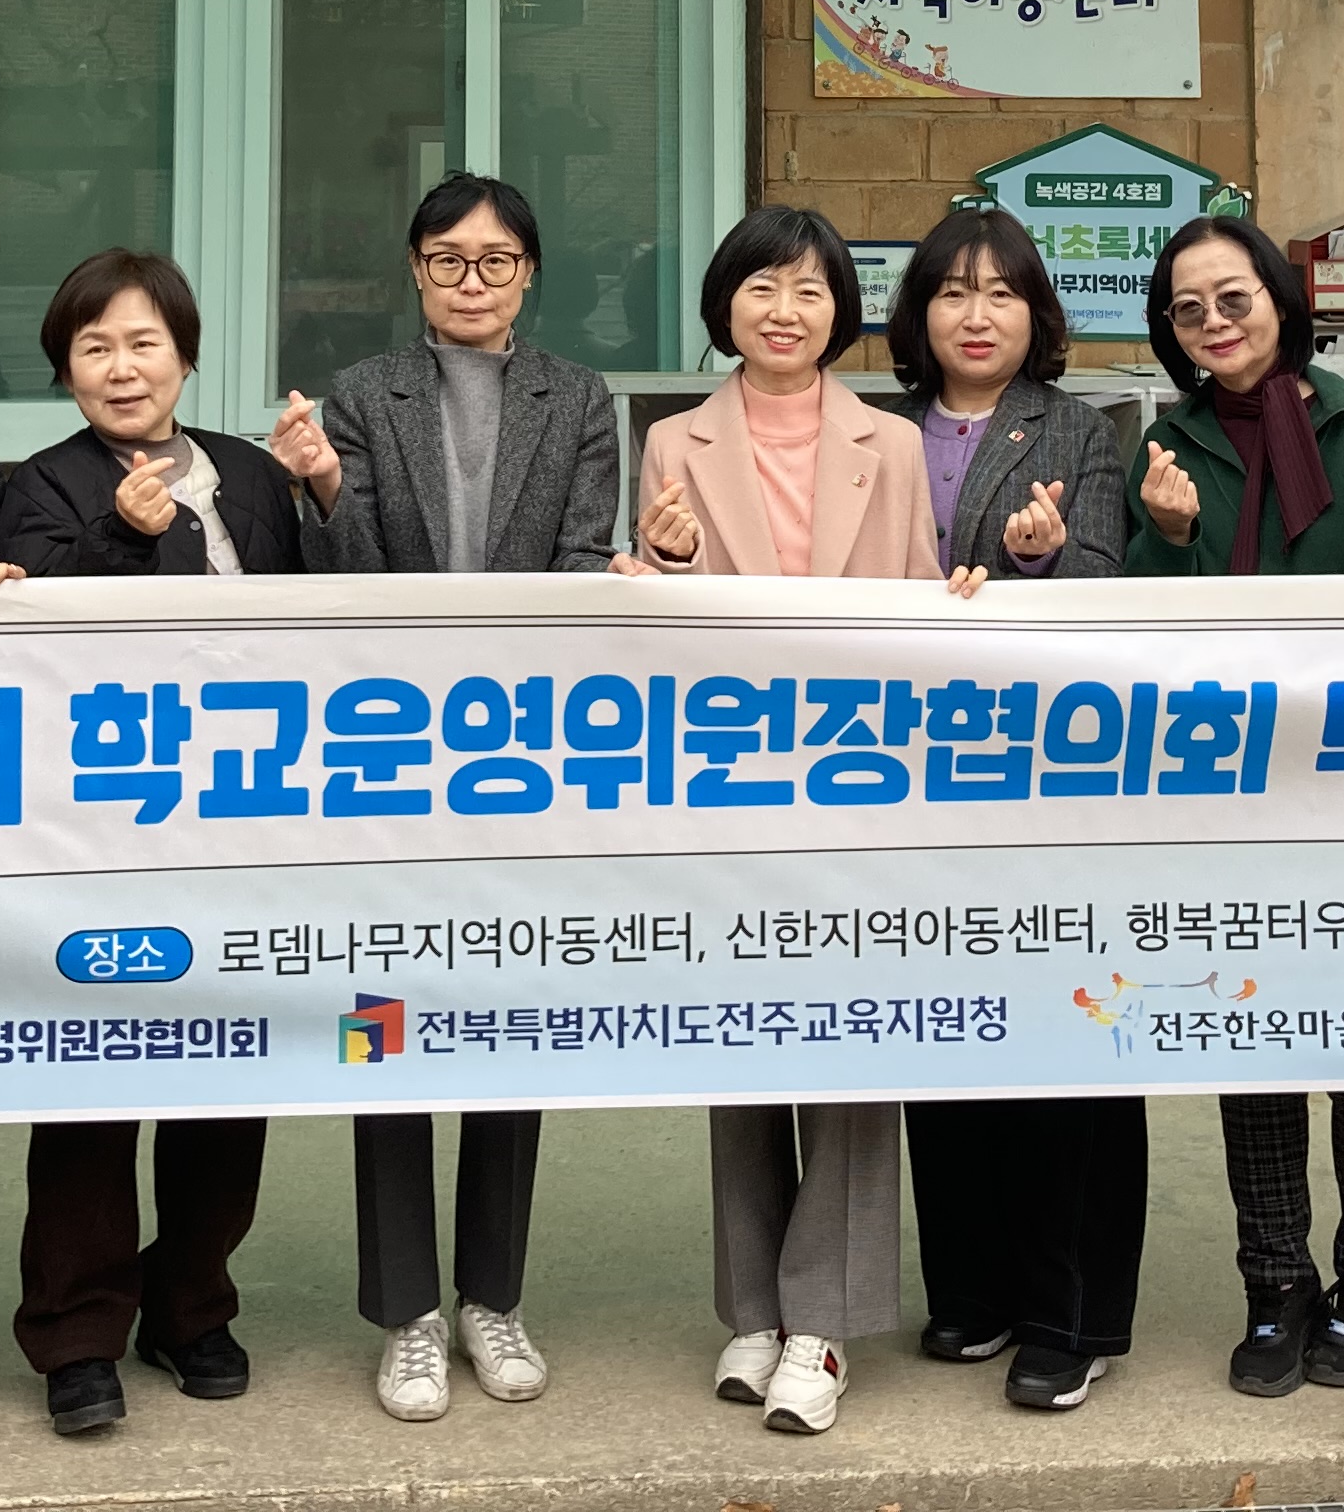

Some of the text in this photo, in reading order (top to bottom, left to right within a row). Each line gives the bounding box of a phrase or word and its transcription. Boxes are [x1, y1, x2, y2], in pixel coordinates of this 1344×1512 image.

[1035, 181, 1162, 201] 녹색공간 4호점
[70, 674, 1277, 825] 학교운영위원장협의회
[83, 932, 166, 977] 장소
[217, 911, 707, 976] 로뎀나무지역아동센터,
[726, 902, 1109, 960] 신한지역아동센터,
[416, 995, 1008, 1054] 전북특별자치도전주교육지원청
